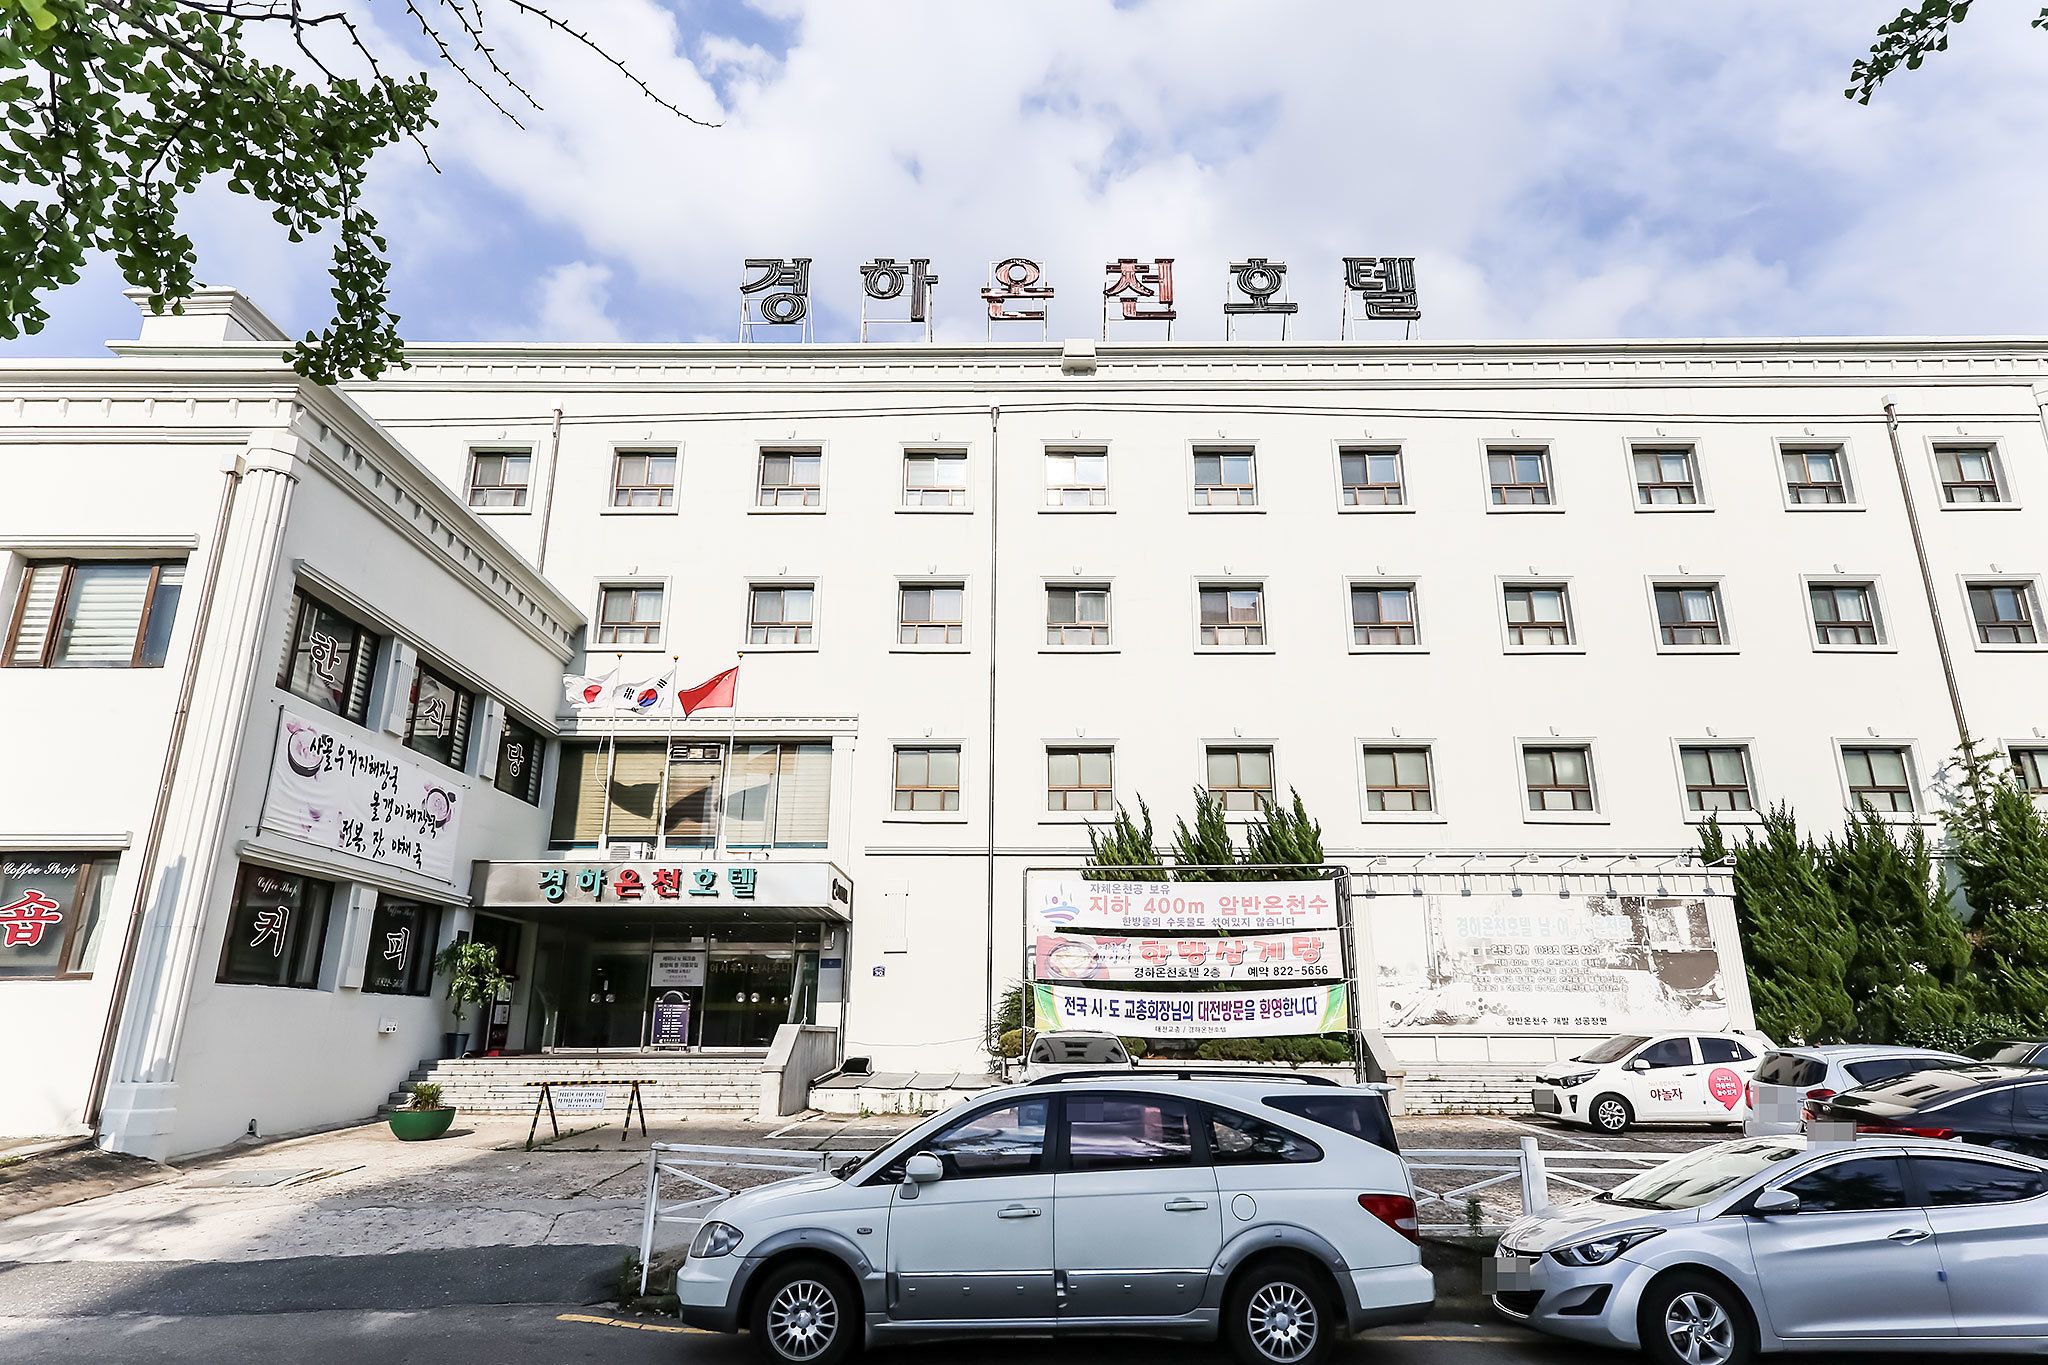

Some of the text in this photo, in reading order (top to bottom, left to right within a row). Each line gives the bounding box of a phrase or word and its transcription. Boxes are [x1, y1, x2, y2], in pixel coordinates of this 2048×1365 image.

[309, 630, 525, 777] 한 식 당
[3, 862, 79, 880] Coffee Shop
[256, 876, 279, 895] Coffee
[538, 868, 757, 904] 경하온천호텔
[1090, 883, 1170, 895] 자체온천공 보유
[1089, 895, 1328, 916] 지하 400m 암반온천수
[0, 888, 63, 948] 숍
[1122, 917, 1160, 927] 한방울의
[1256, 917, 1295, 927] 않습니다
[250, 905, 410, 971] 커 피
[1139, 936, 1324, 966] 한방삼계탕
[1134, 967, 1199, 978] 경하온천호텔
[1203, 967, 1221, 978] 2층
[1247, 966, 1269, 978] 예약
[1273, 965, 1328, 976] 822-5656
[1064, 996, 1088, 1017] 전국
[1124, 999, 1194, 1021] 교총회장님의
[1198, 999, 1256, 1022] 대전방문을
[1259, 996, 1318, 1020] 환영합니다
[1507, 1017, 1608, 1026] 암반온천수 개발 성공장면
[1650, 1088, 1683, 1101] 야놀자
